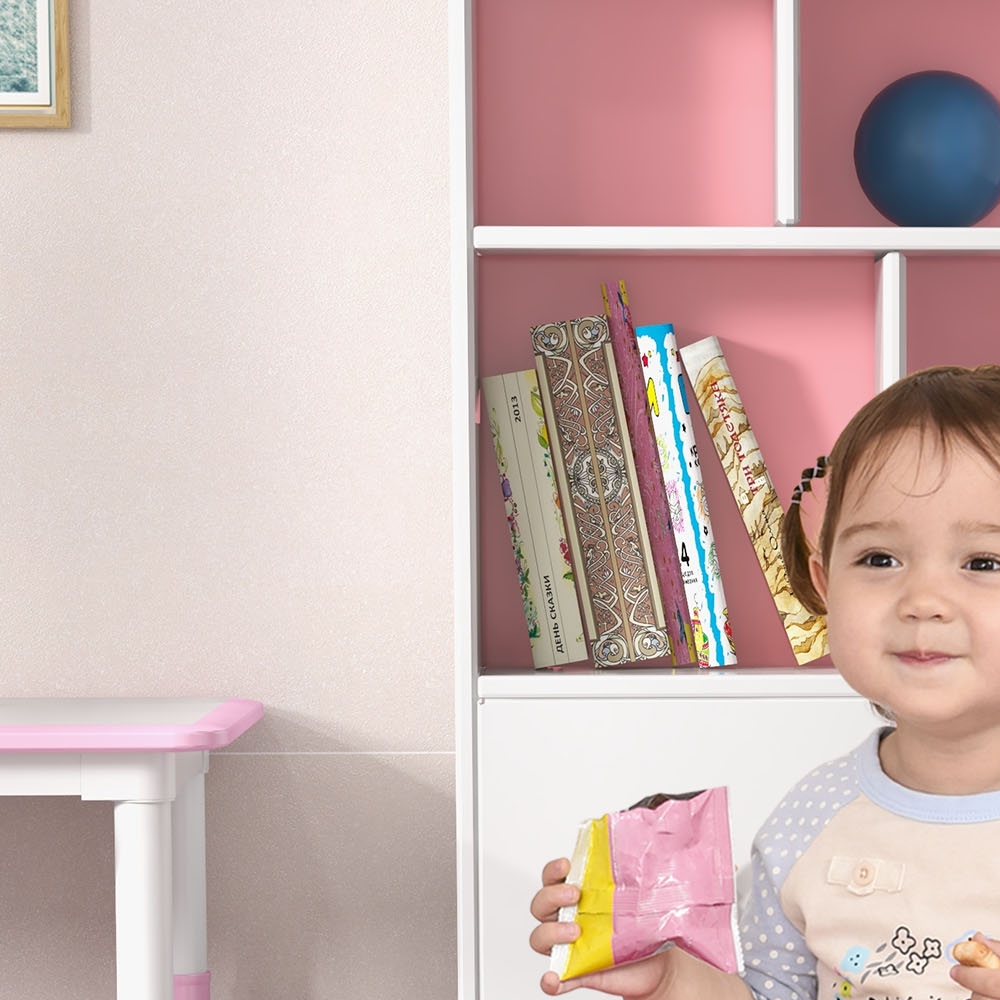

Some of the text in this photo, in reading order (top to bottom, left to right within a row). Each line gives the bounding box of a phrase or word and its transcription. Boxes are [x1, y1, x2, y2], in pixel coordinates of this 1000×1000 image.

[511, 395, 521, 422] 2013
[742, 465, 759, 496] ТРИ
[681, 541, 690, 567] 4
[543, 575, 564, 653] ДЕНЬ СКАЗКИ
